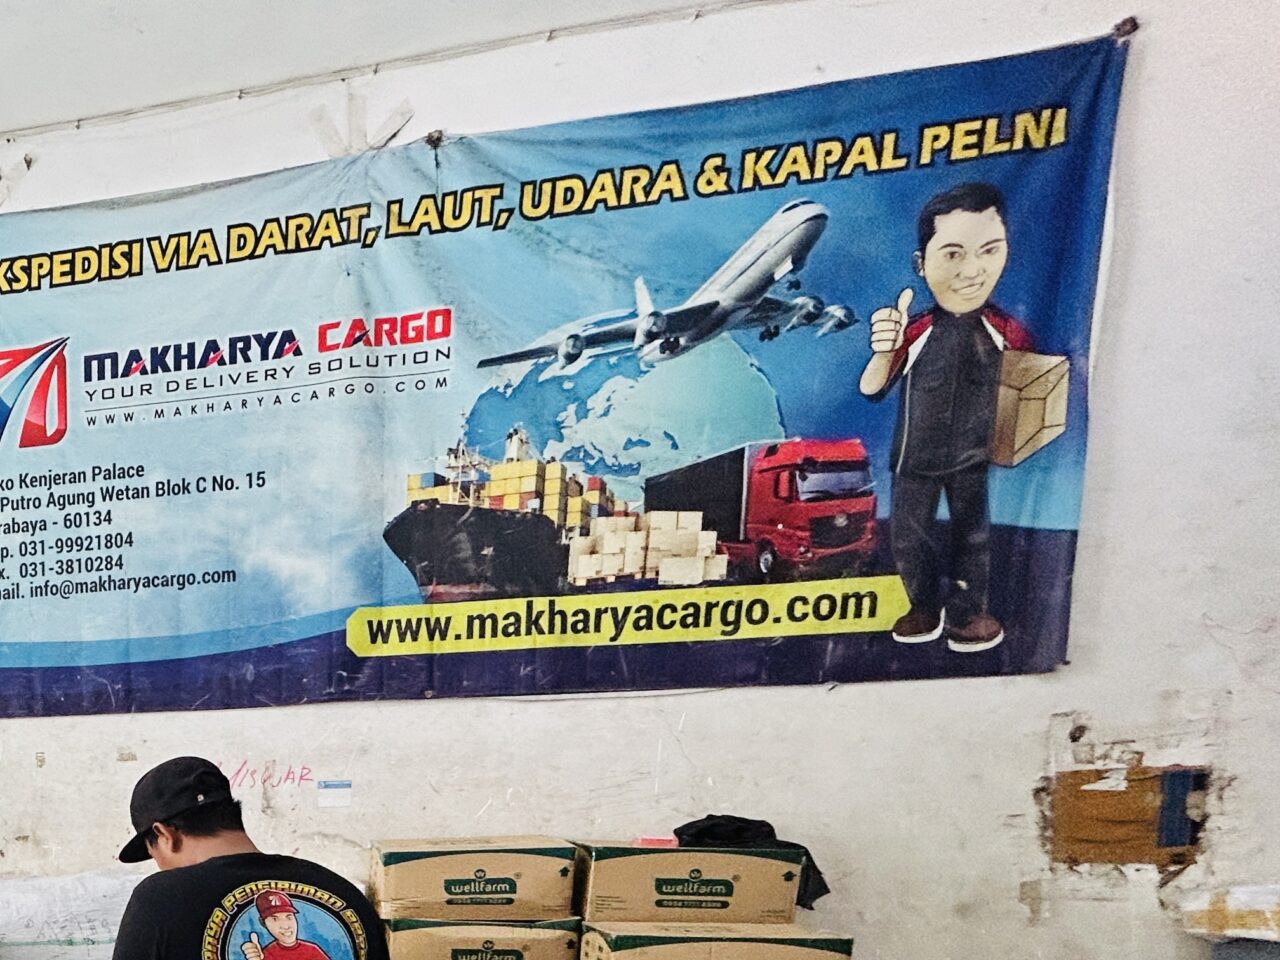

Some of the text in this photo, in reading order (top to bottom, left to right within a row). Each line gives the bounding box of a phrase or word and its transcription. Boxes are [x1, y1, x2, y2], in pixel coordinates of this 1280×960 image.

[147, 227, 221, 272] VIA
[227, 203, 381, 262] DARAT,
[385, 183, 514, 237] LAUT,
[519, 163, 686, 221] UDARA
[697, 160, 730, 197] &
[740, 134, 908, 192] KAPAL
[919, 107, 1070, 167] PELNI
[83, 308, 452, 382] MAKHARYA CARGO
[85, 346, 452, 402] YOUR DELIVERY SOLUTION
[86, 377, 449, 427] WWW.MAKHARYACARGO.COM
[0, 496, 42, 512] Putro
[46, 490, 96, 510] Agung
[100, 485, 150, 502] Wetan
[155, 479, 191, 497] Blok
[196, 477, 207, 493] C
[212, 475, 240, 492] No.
[246, 471, 266, 489] 15
[19, 469, 87, 490] Kenjeran
[92, 463, 145, 482] Palace
[63, 510, 113, 530] 60134
[19, 532, 134, 558] 031-99921804
[19, 555, 124, 579] 031-3810284
[30, 567, 237, 599] info@makharyacargo.com
[366, 584, 879, 647] www.makharyacargo.com
[451, 881, 510, 893] wellfarm
[662, 883, 727, 894] wellfarm
